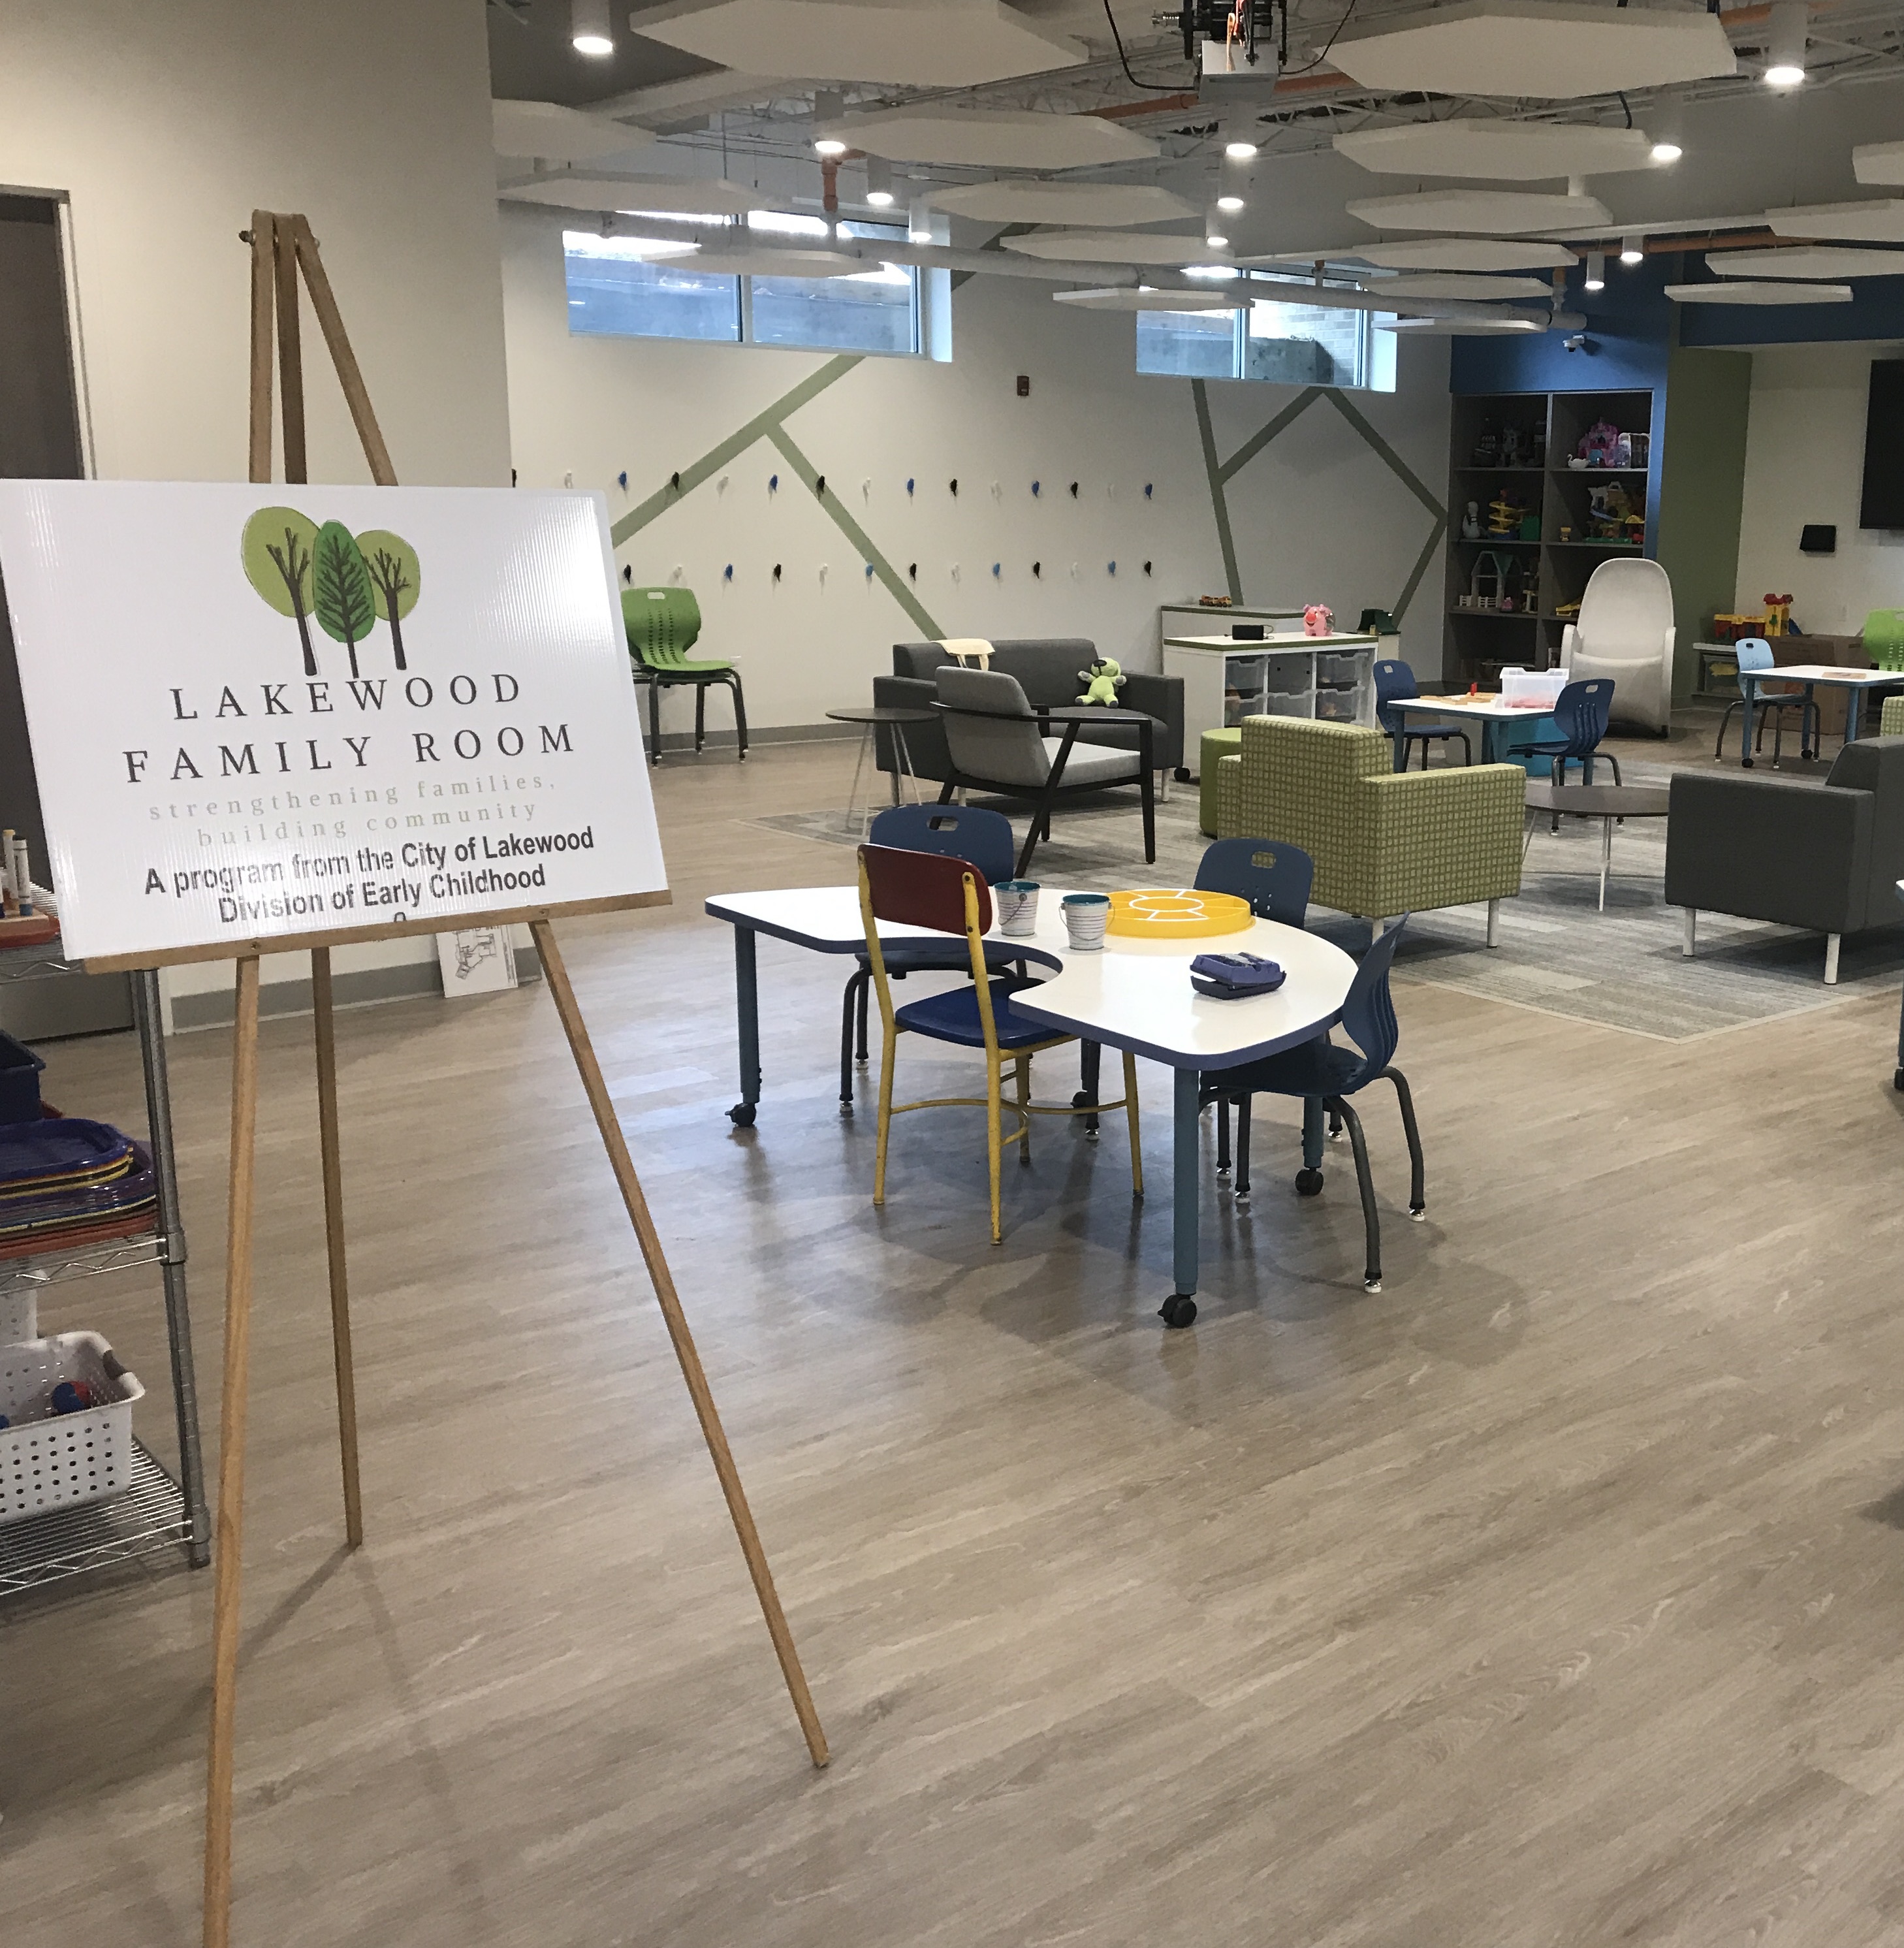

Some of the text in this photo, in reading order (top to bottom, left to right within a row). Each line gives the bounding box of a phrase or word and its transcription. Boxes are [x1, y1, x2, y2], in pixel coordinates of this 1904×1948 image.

[170, 673, 519, 720] LAKEWOOD
[122, 724, 573, 783] FAMILY ROOM
[150, 774, 555, 820] strengthening families,
[198, 803, 535, 847] building community
[145, 825, 594, 898] A program from the City of Lakewood
[218, 863, 546, 923] Division of Early Childhood
